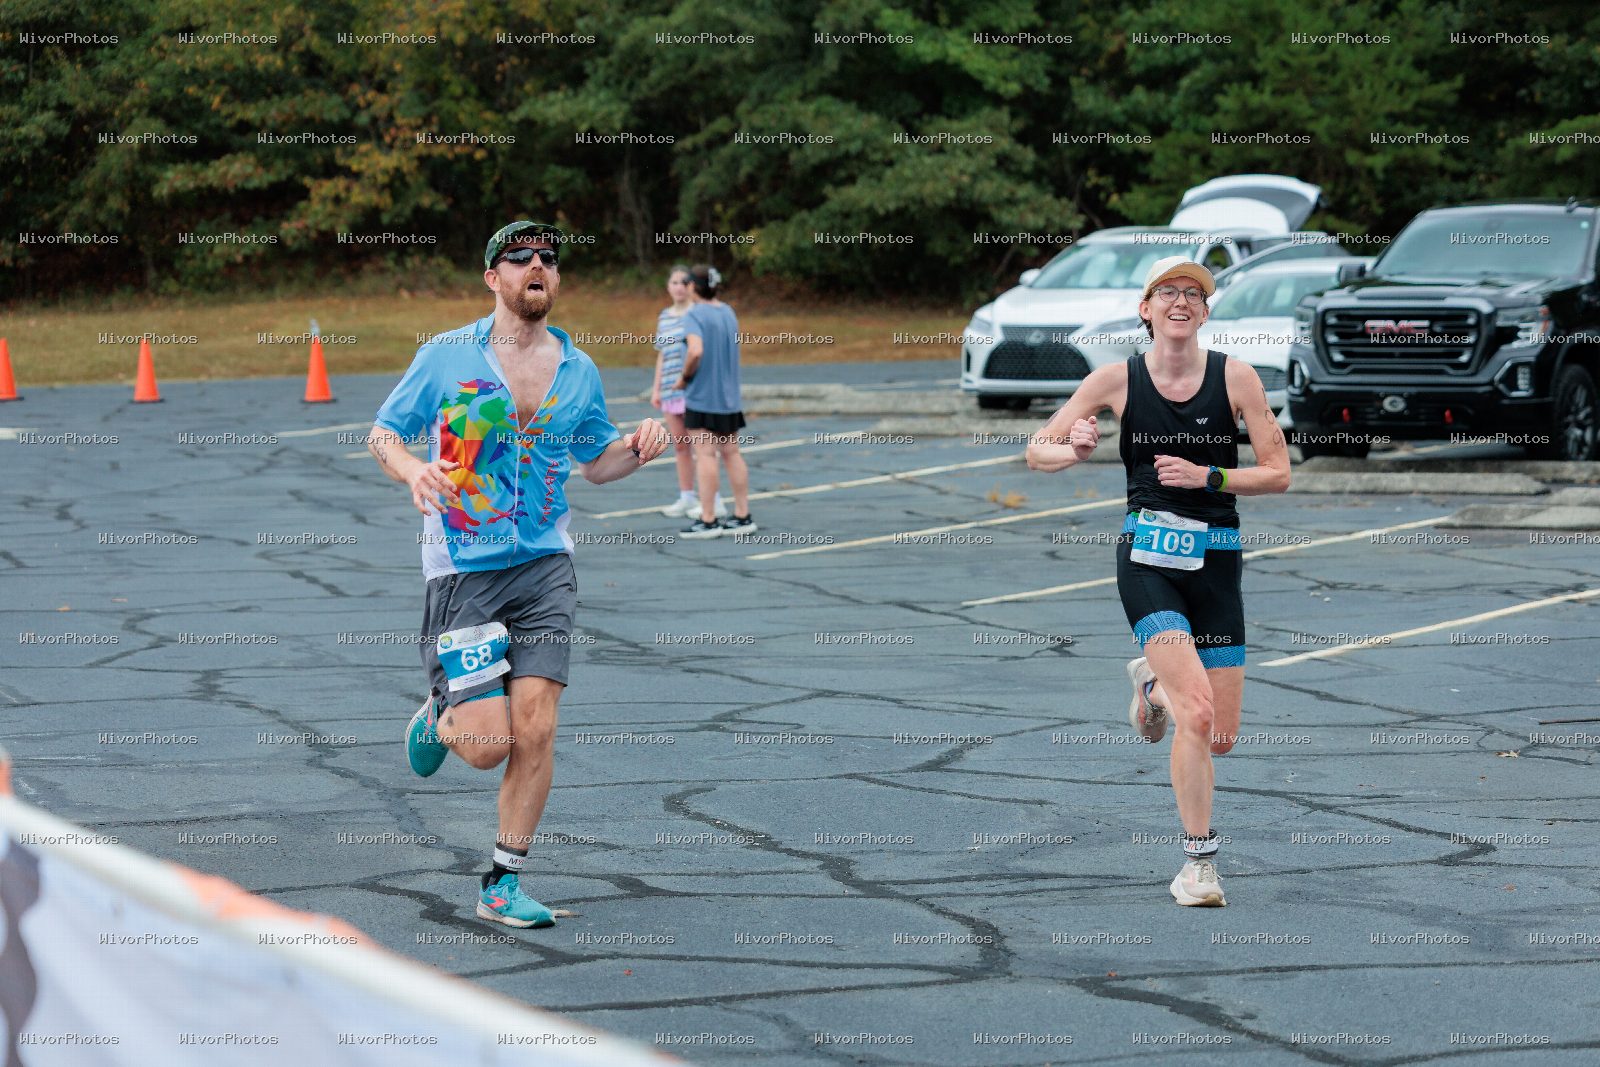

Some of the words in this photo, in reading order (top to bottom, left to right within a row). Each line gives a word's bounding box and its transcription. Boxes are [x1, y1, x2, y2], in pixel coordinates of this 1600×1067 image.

[1364, 320, 1430, 335] GMC
[1149, 528, 1195, 555] 109
[461, 644, 493, 671] 68
